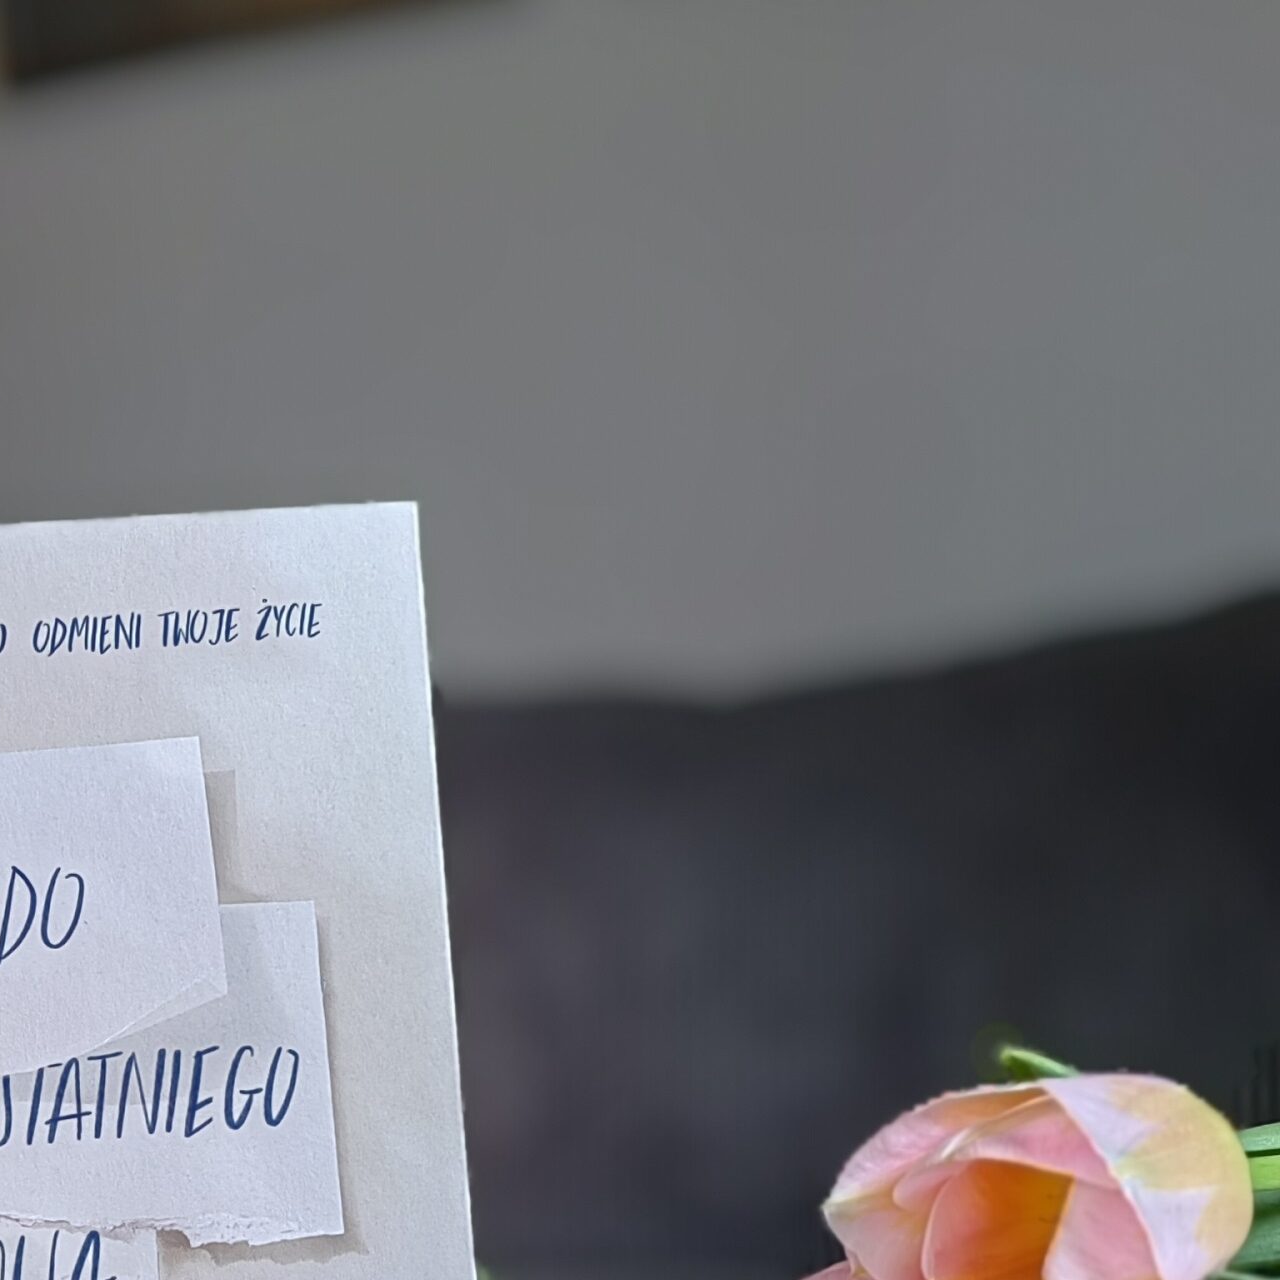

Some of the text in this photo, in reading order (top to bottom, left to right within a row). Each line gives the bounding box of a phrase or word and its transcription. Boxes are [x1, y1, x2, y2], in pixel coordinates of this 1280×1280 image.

[32, 612, 142, 657] ODMIENI
[157, 608, 241, 648] TWOJE
[255, 599, 324, 642] ŻYCIE
